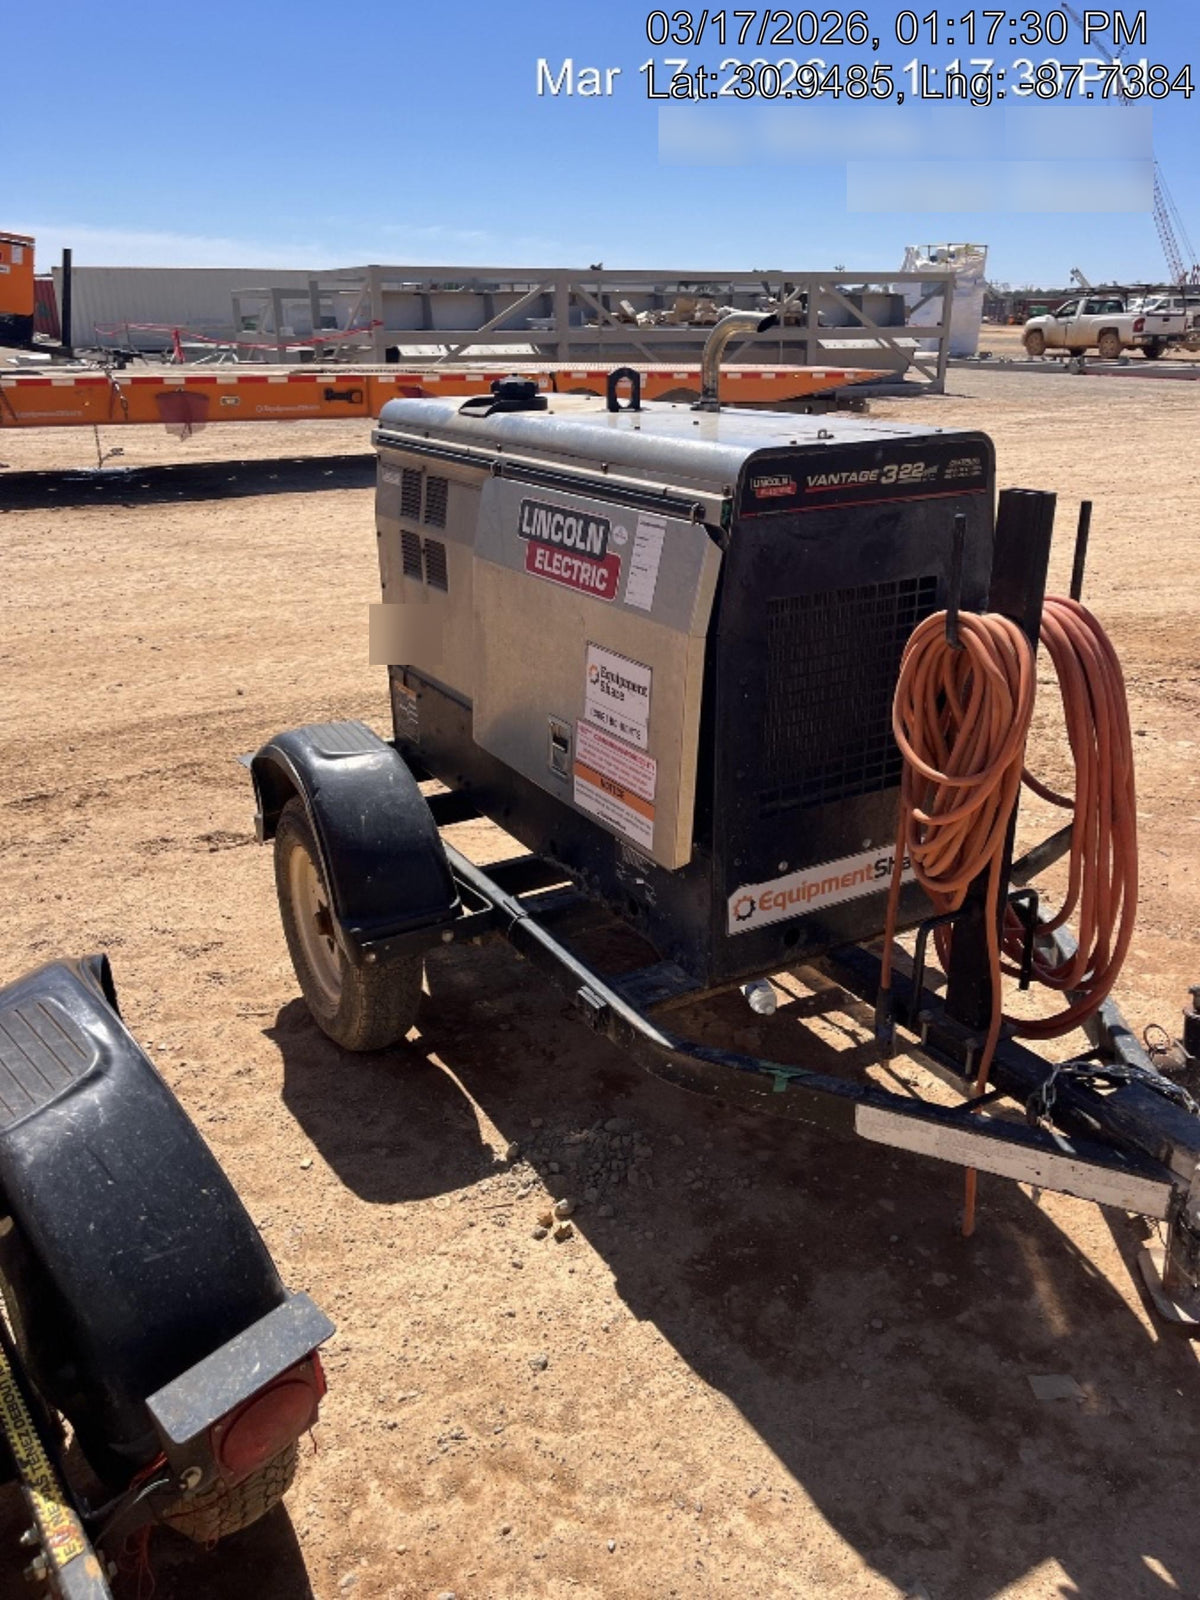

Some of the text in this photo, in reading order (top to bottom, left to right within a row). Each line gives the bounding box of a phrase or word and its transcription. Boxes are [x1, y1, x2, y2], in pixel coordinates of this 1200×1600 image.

[806, 469, 880, 487] VANTAGE
[880, 461, 926, 485] 322
[521, 505, 605, 556] LINCOLN
[534, 546, 609, 591] ELECTRIC
